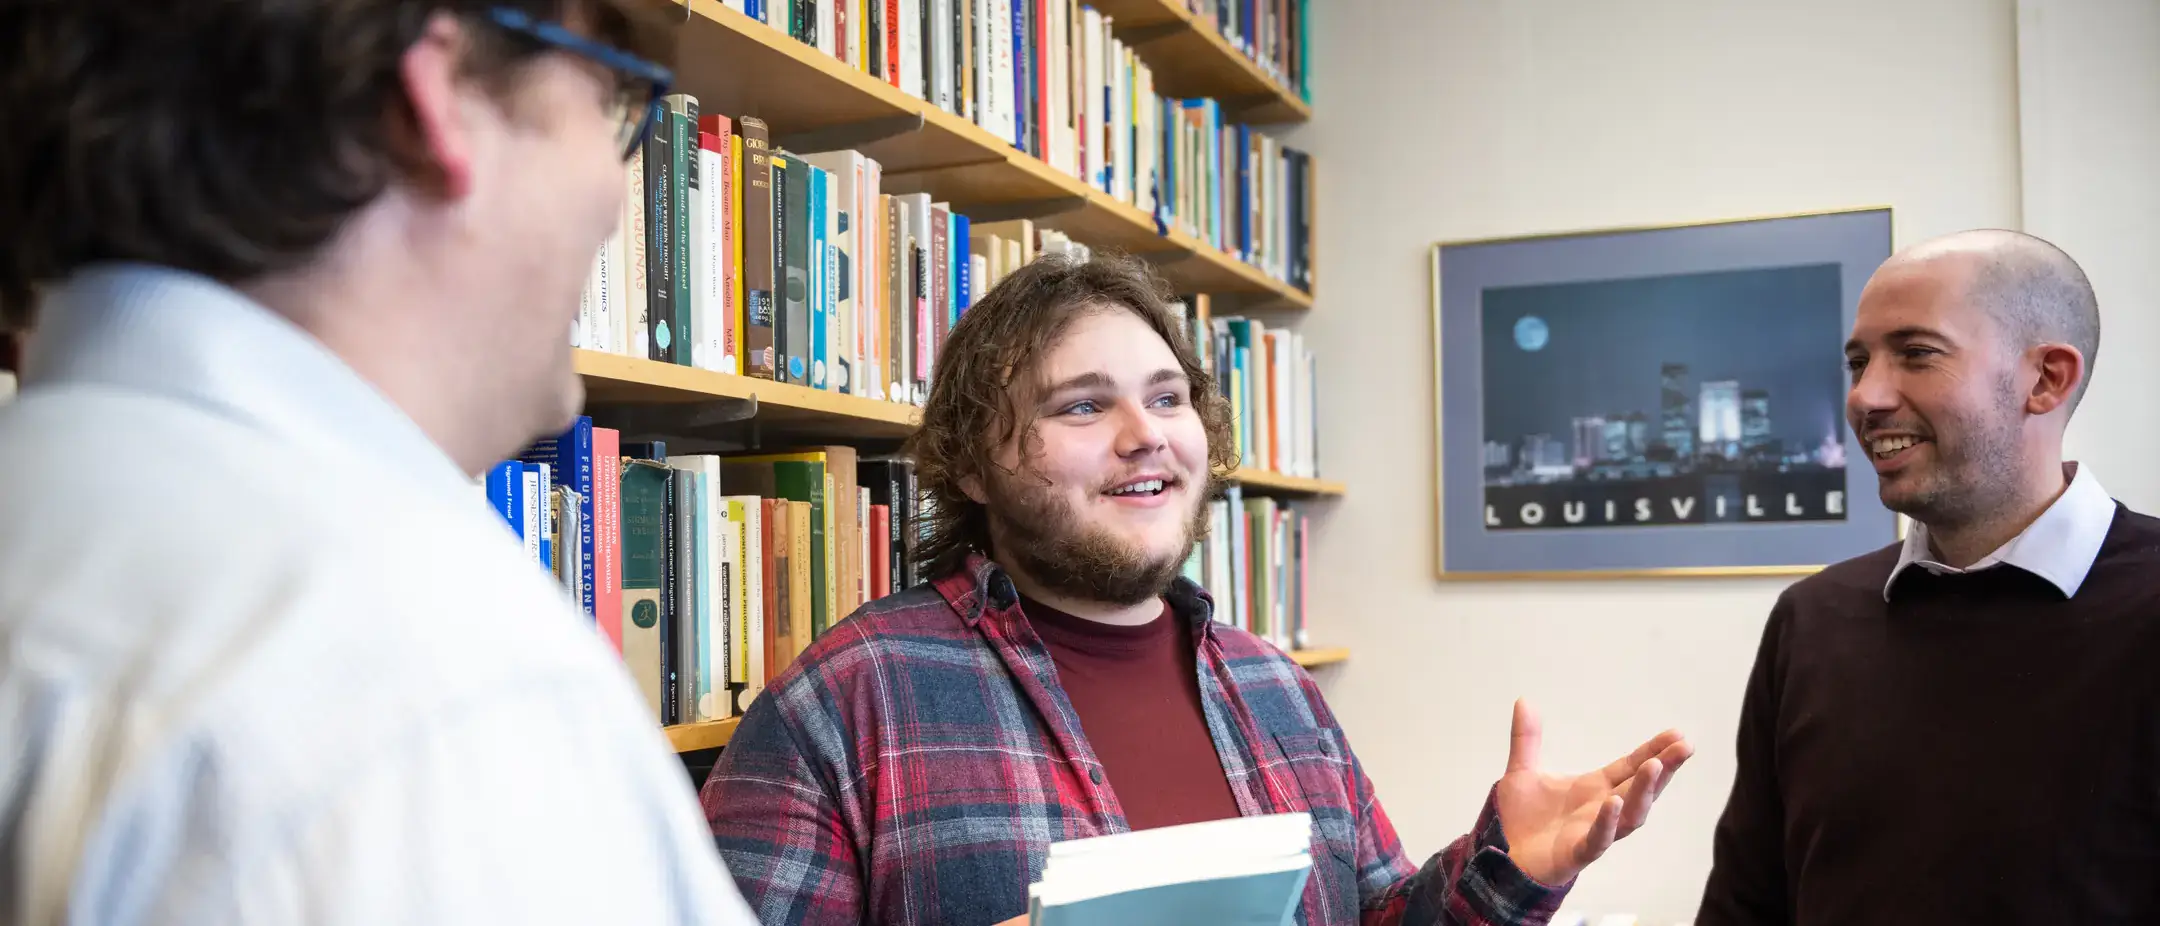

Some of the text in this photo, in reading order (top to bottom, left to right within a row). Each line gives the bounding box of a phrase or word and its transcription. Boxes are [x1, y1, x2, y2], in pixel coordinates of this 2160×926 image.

[678, 189, 687, 211] guide
[723, 181, 731, 216] Became
[679, 214, 687, 228] for
[633, 203, 646, 291] AQUINAS
[680, 247, 689, 290] perplexed
[504, 465, 513, 497] Sigmund
[581, 456, 590, 504] FREUD
[506, 498, 514, 519] Freud
[1485, 490, 1845, 527] LOUISVILLE
[582, 512, 591, 545] AND
[583, 552, 593, 615] BEYOND
[723, 644, 731, 690] experience
